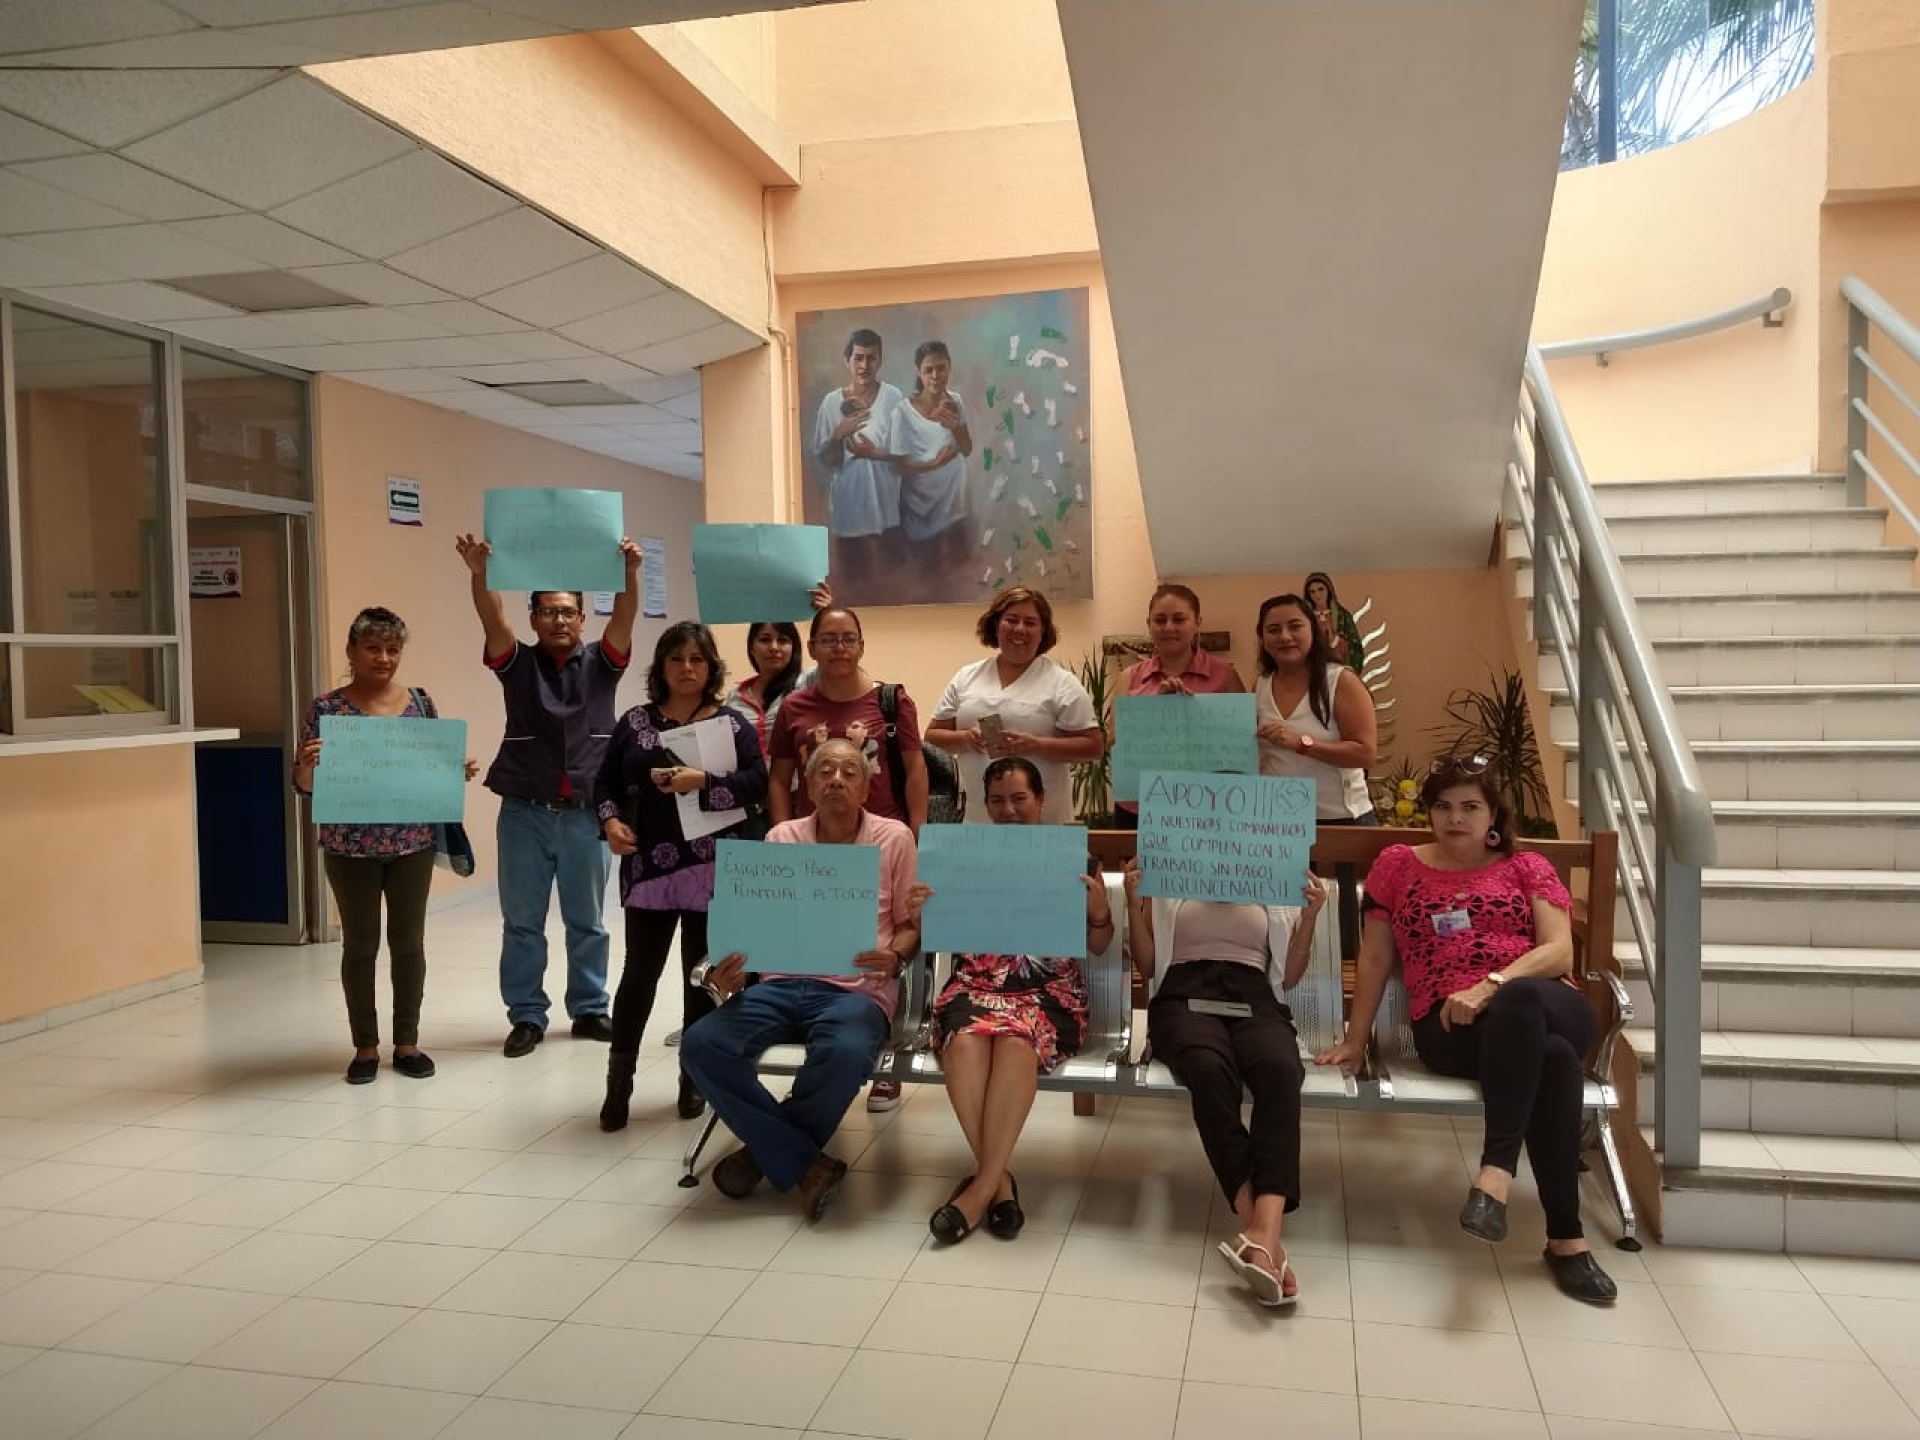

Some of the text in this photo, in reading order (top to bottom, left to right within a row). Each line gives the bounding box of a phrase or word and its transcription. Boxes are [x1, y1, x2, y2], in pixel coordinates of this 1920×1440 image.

[1143, 811, 1153, 826] A
[1143, 832, 1292, 860] QUE CUMPLEN CON SU
[803, 858, 838, 877] PAGO
[1141, 854, 1273, 880] TRABAJO SIN PAGOS
